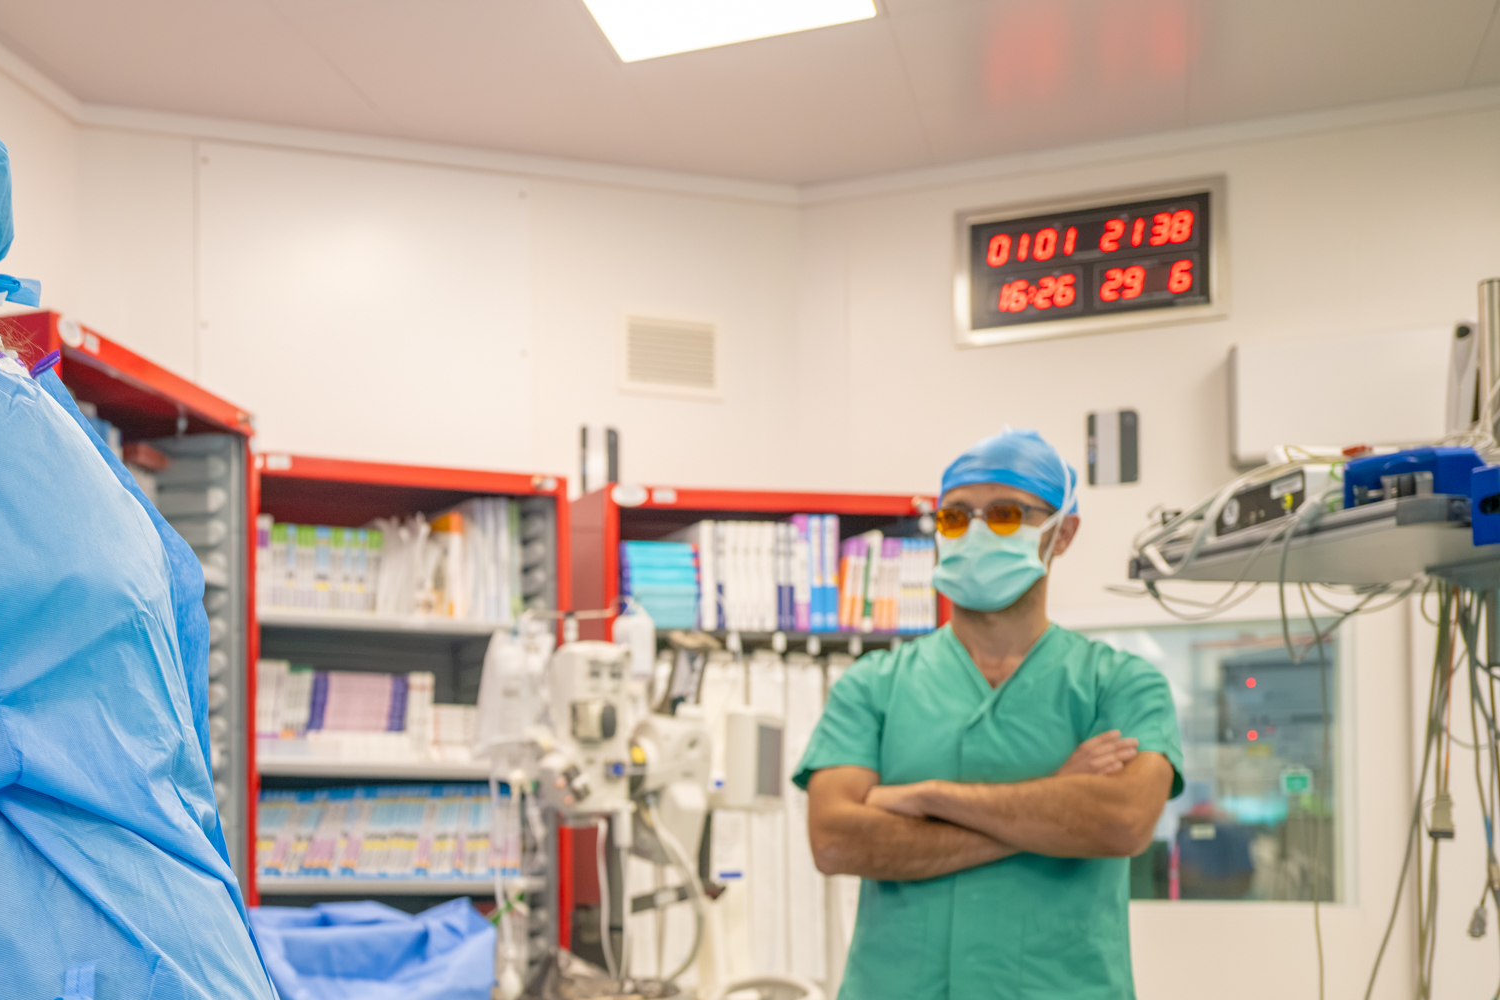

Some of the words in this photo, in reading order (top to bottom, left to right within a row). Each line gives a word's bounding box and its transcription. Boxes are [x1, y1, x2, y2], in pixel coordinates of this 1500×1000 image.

[998, 273, 1077, 313] 16:26
[1099, 265, 1146, 302] 29
[1167, 259, 1193, 294] 6
